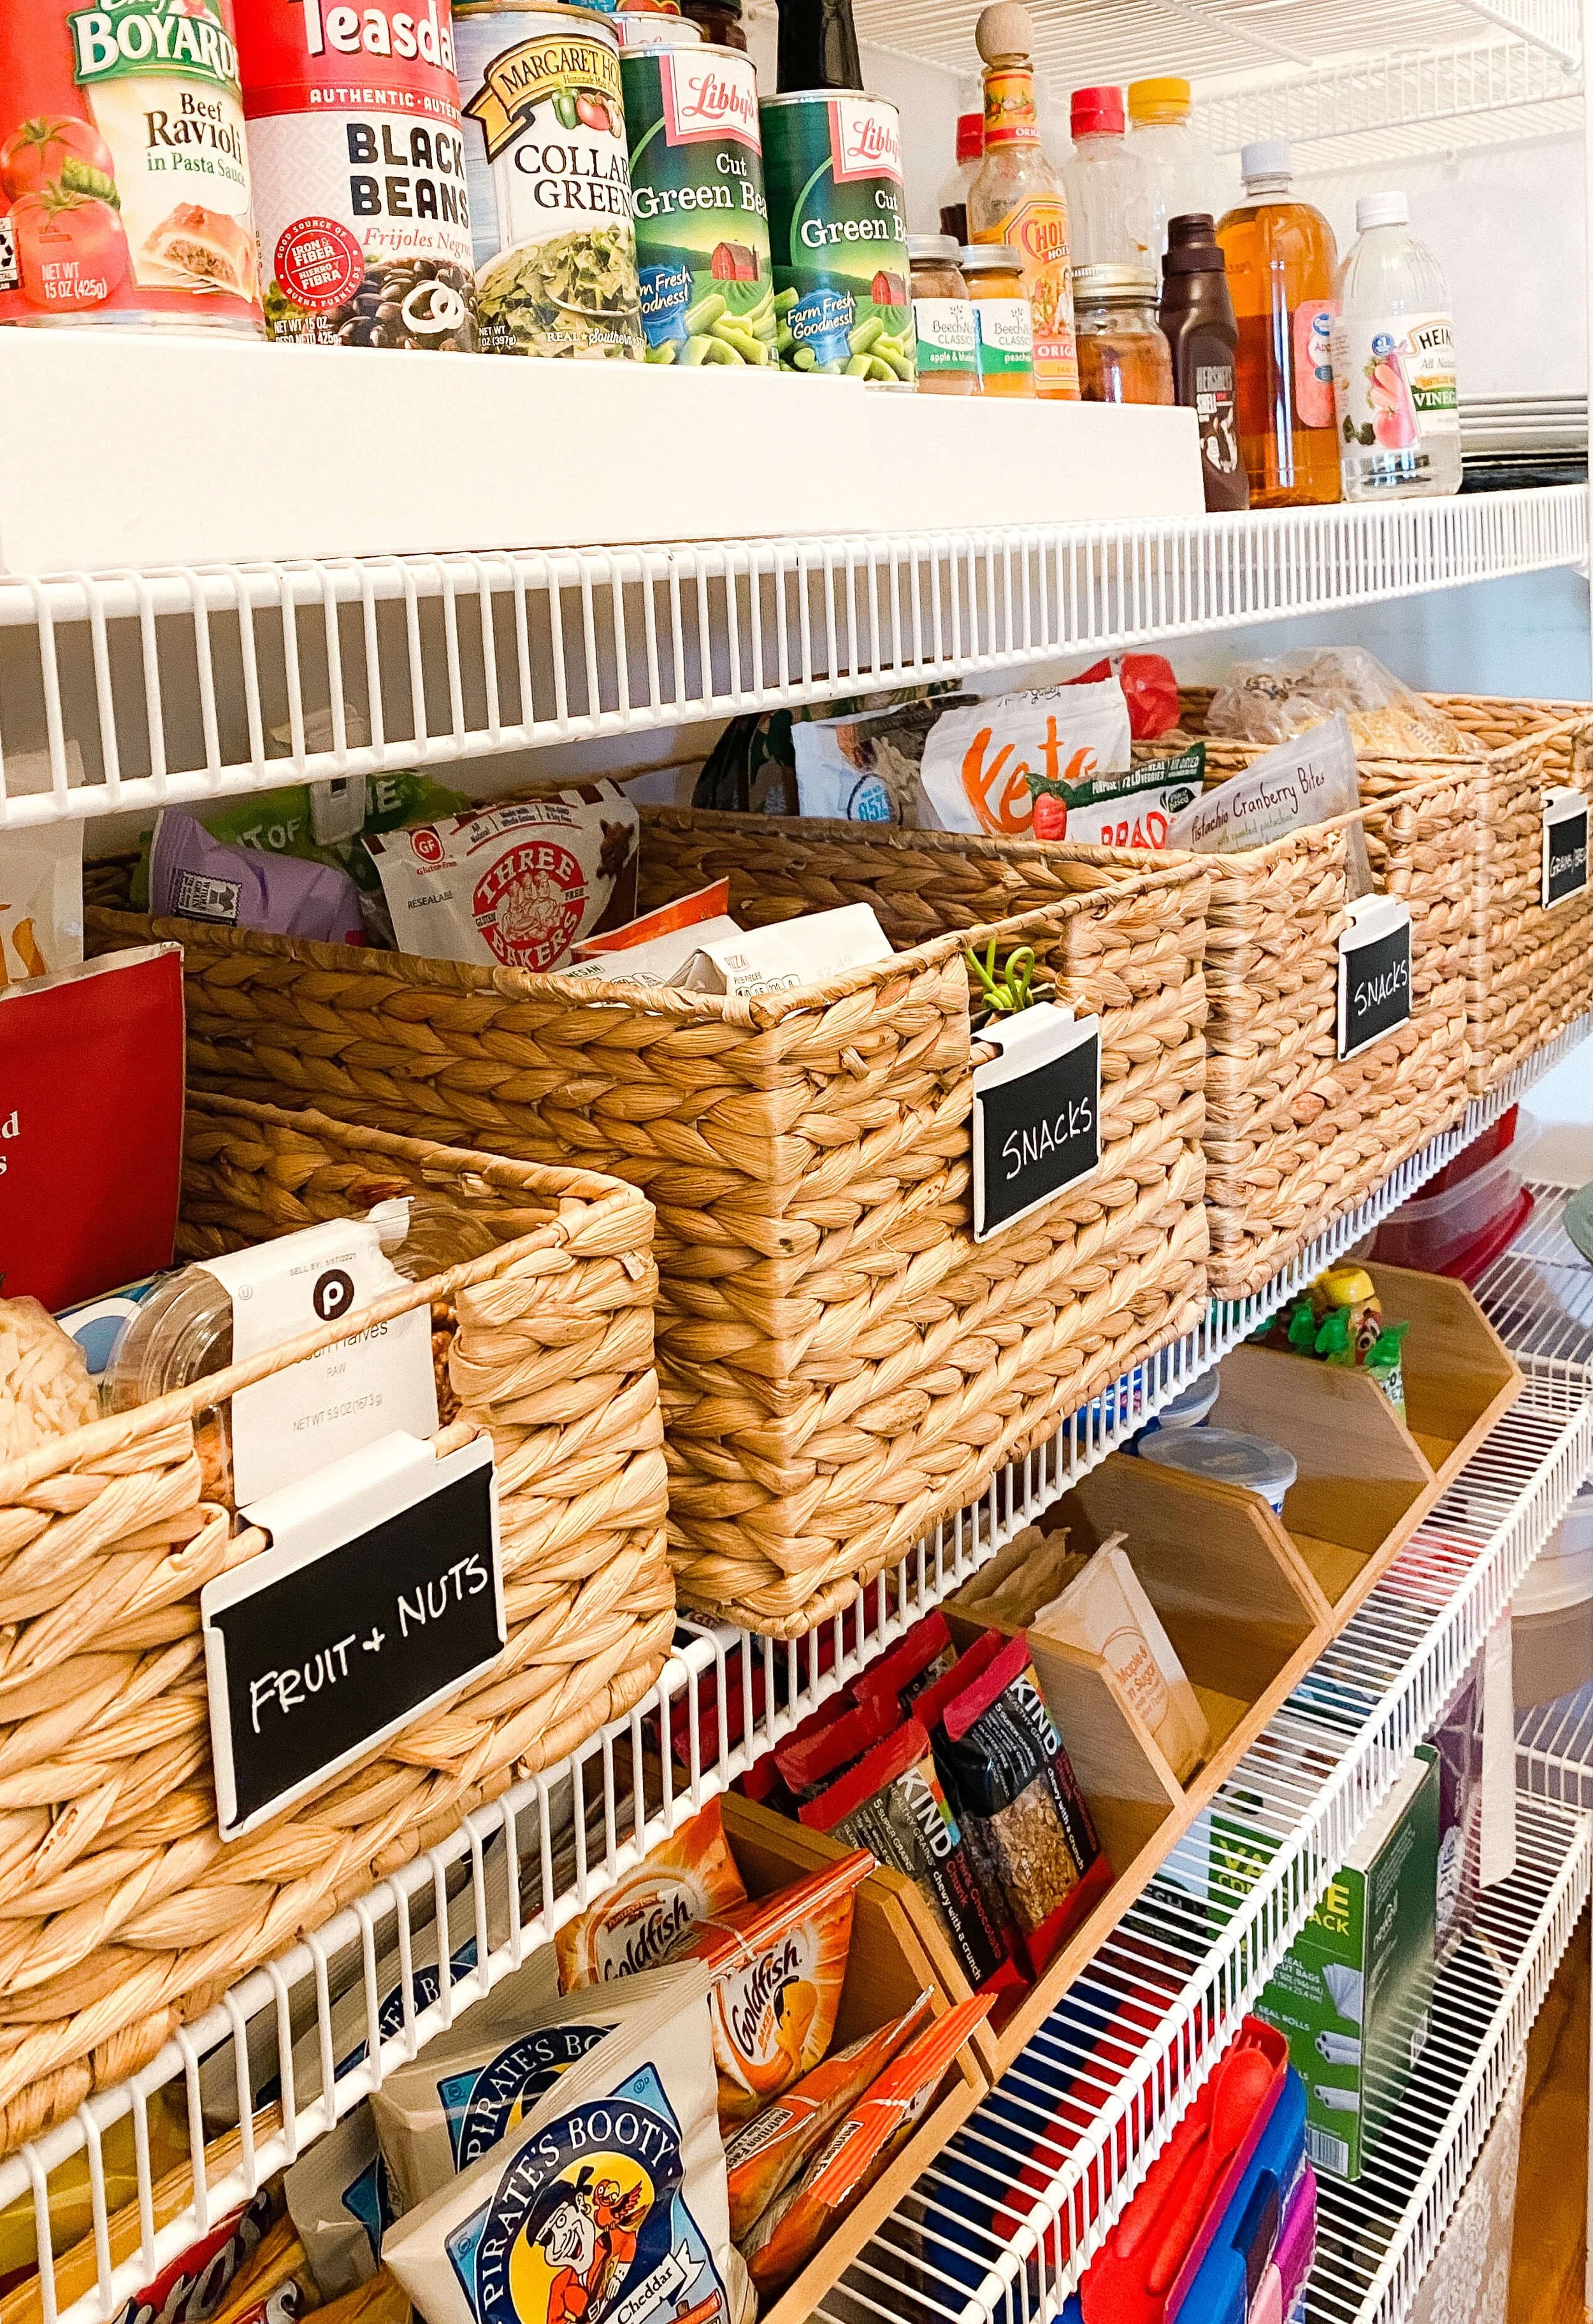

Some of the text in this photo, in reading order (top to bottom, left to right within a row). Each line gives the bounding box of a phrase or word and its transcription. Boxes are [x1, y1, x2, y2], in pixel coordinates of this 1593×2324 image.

[75, 13, 241, 88] BOYARD
[499, 48, 598, 94] MARGARET
[180, 93, 223, 123] Beef
[310, 88, 414, 108] AUTHENTIC
[682, 73, 754, 124] Libby's
[143, 110, 243, 166] Ravioli
[346, 123, 465, 179] BLACK
[147, 152, 246, 187] in Pasta Sauce
[514, 145, 631, 186] COLLAR
[716, 153, 747, 177] Cut
[350, 175, 469, 230] BEANS
[632, 182, 735, 219] Green
[876, 190, 898, 211] Cut
[277, 220, 347, 259] GOOD SOURCE OF
[291, 237, 330, 256] IRON &
[363, 227, 432, 250] Frijoles
[801, 217, 886, 248] Green
[41, 261, 80, 281] NET WT
[294, 245, 335, 266] FIBER
[299, 261, 340, 280] HIERRO Y
[44, 277, 107, 299] 15 OZ (425g)
[286, 266, 361, 308] BUENA FUENTE DE
[301, 269, 342, 289] FIBRA
[656, 265, 693, 293] Fresh
[642, 283, 689, 313] odness!
[788, 291, 856, 329] Farm Fresh
[274, 317, 328, 334] NET WT 15 OZ
[479, 326, 506, 336] NET WT
[493, 335, 517, 346] (397g)
[547, 332, 579, 342] REAL
[589, 328, 633, 345] Southern
[793, 312, 853, 340] Goodness!
[930, 352, 951, 362] apple
[1141, 771, 1165, 784] VEGGIES
[1192, 800, 1229, 845] Pistachio
[1233, 782, 1299, 818] Cranberry
[1297, 763, 1325, 794] Bites
[419, 840, 435, 854] GF
[478, 847, 575, 904] THREE
[565, 887, 585, 901] FREE
[491, 914, 577, 968] BAKERS
[1354, 959, 1408, 1016] SNACKS
[1002, 1097, 1093, 1179] SNACKS
[327, 1363, 346, 1377] RAW
[293, 1417, 310, 1431] NET
[312, 1412, 324, 1426] WT
[340, 1402, 352, 1416] OZ
[250, 1634, 357, 1734] FRUIT
[398, 1553, 489, 1637] NUTS
[995, 1702, 1003, 1712] 5
[1000, 1711, 1020, 1738] SUPER
[1004, 1689, 1049, 1763] HEALTHY GRAINS
[1009, 1673, 1058, 1756] KIND
[874, 1798, 883, 1809] 5
[896, 1767, 952, 1858] KIND
[1048, 1767, 1060, 1800] chewy
[1058, 1800, 1070, 1825] with
[1069, 1833, 1085, 1871] crunch
[877, 1808, 895, 1839] SUPER
[888, 1784, 916, 1826] HEALTHY
[912, 1827, 934, 1867] GRAINS
[893, 1837, 915, 1872] GRAINS
[956, 1850, 1002, 1959] Dark Chocolate
[604, 1893, 691, 1981] Goldfish
[933, 1870, 982, 1981] chewy with a crunch
[1308, 1910, 1350, 1936] ACK
[1295, 1968, 1321, 1984] BAGS
[732, 1939, 801, 2057] Goldfish
[1258, 2005, 1311, 2032] SEAL ROLLS
[467, 2039, 554, 2160] PIRATE'S
[747, 2111, 791, 2148] Nutrition
[484, 2109, 675, 2311] PIRATE'S BOOTY
[617, 2267, 673, 2324] Cheddar
